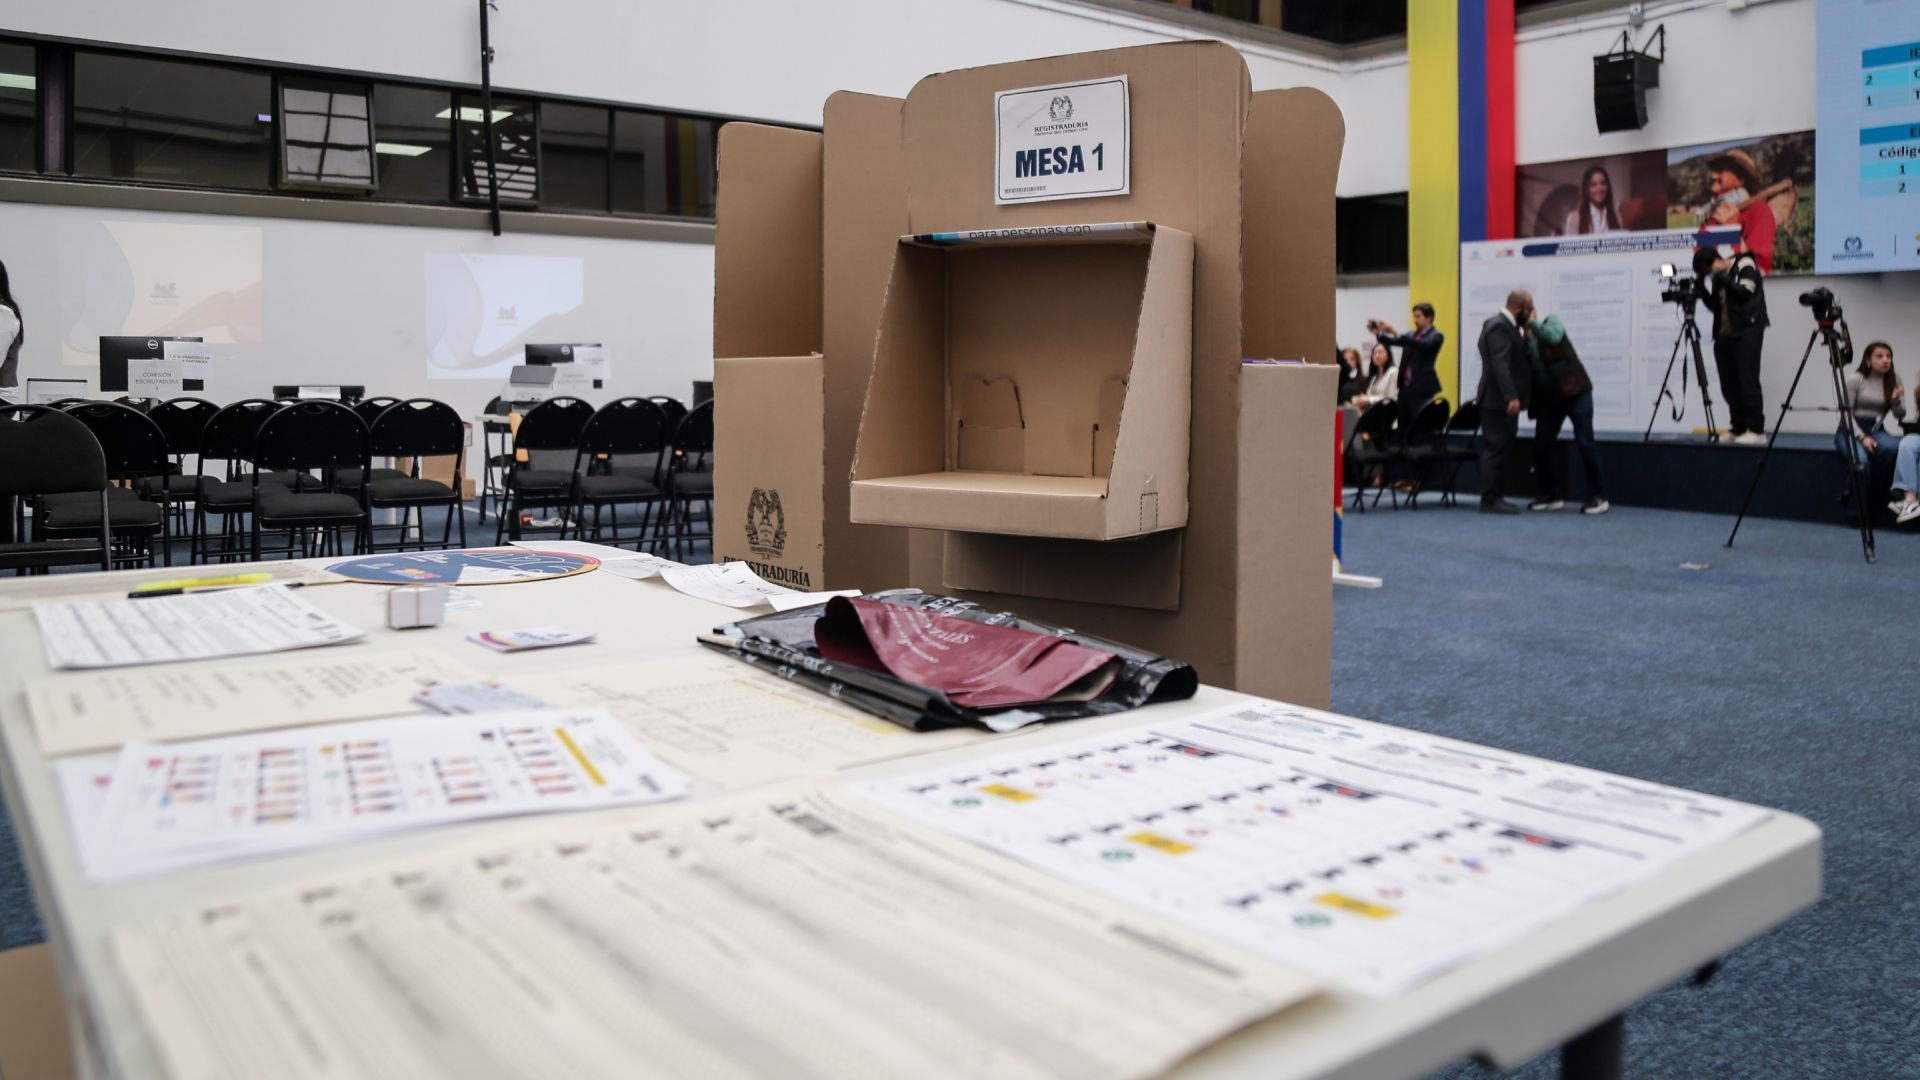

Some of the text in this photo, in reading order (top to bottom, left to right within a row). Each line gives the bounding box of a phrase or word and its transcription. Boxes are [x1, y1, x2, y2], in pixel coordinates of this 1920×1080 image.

[1865, 76, 1873, 86] 2
[1865, 96, 1872, 106] 1
[1910, 127, 1920, 138] E
[1879, 145, 1920, 159] Códig
[1015, 143, 1104, 179] MESA 1
[1899, 164, 1905, 175] 1
[1898, 182, 1906, 193] 2
[969, 224, 1092, 240] para personas con
[723, 556, 811, 587] RSTRADURÍA
